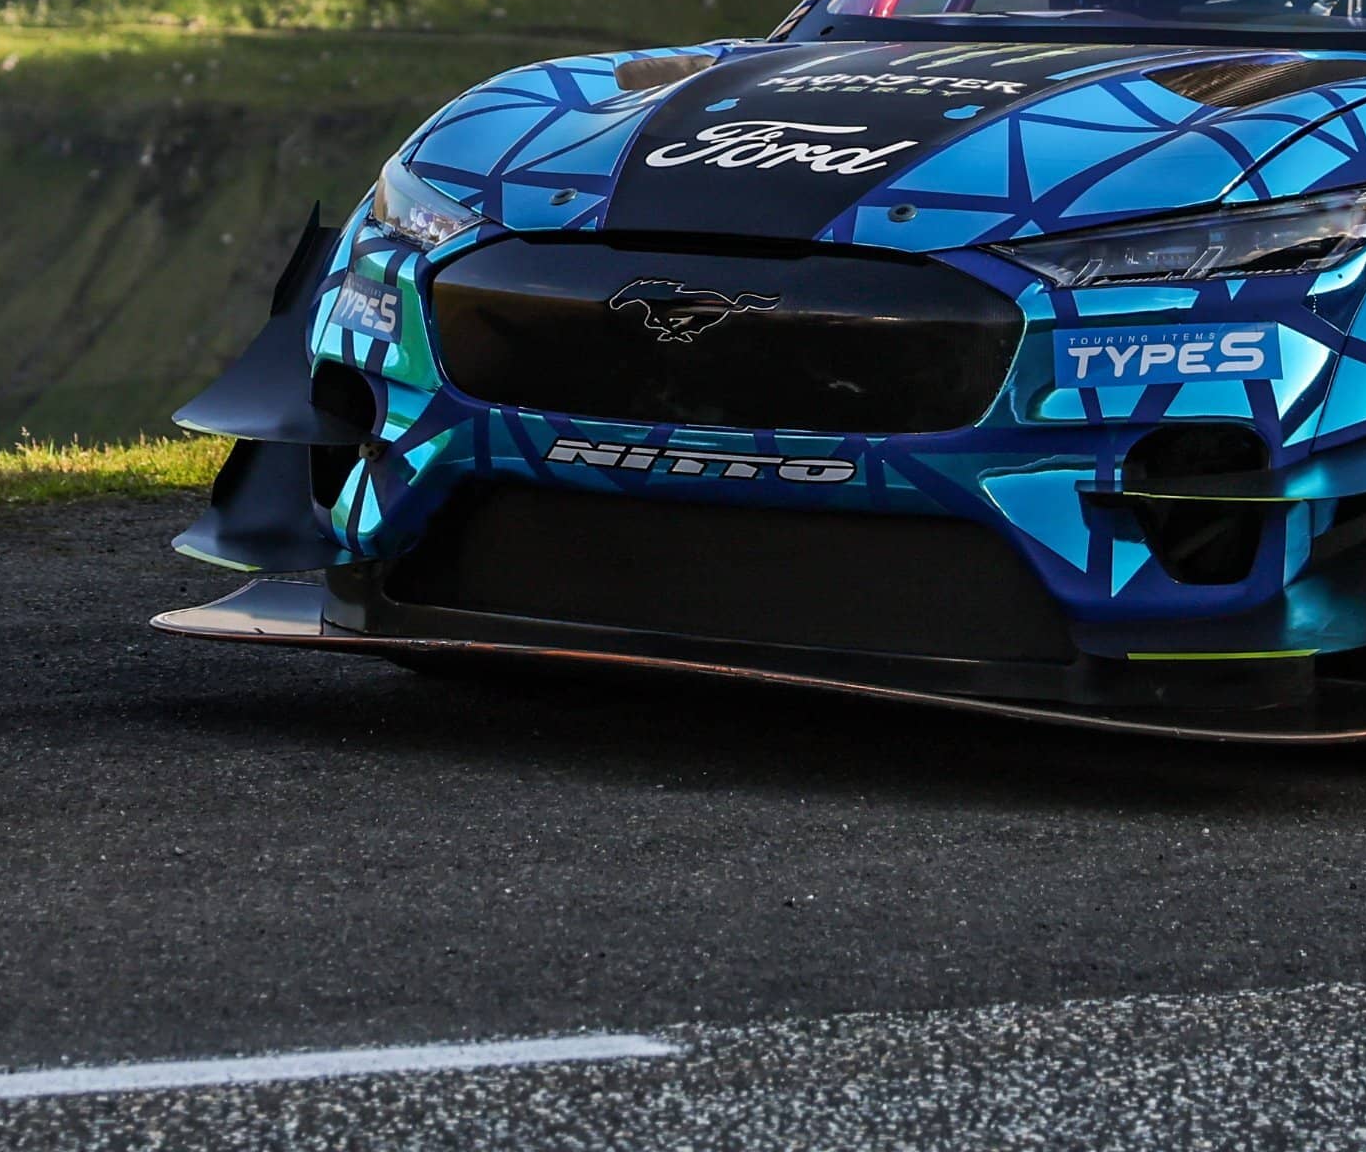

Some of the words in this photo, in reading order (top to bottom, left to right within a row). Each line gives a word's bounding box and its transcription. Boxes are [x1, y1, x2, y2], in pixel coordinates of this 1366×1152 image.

[757, 73, 1028, 95] MONSTER
[645, 120, 920, 175] Ford
[1069, 334, 1149, 346] TOURING
[1162, 332, 1217, 342] ITEMS
[544, 437, 857, 484] NITTO
